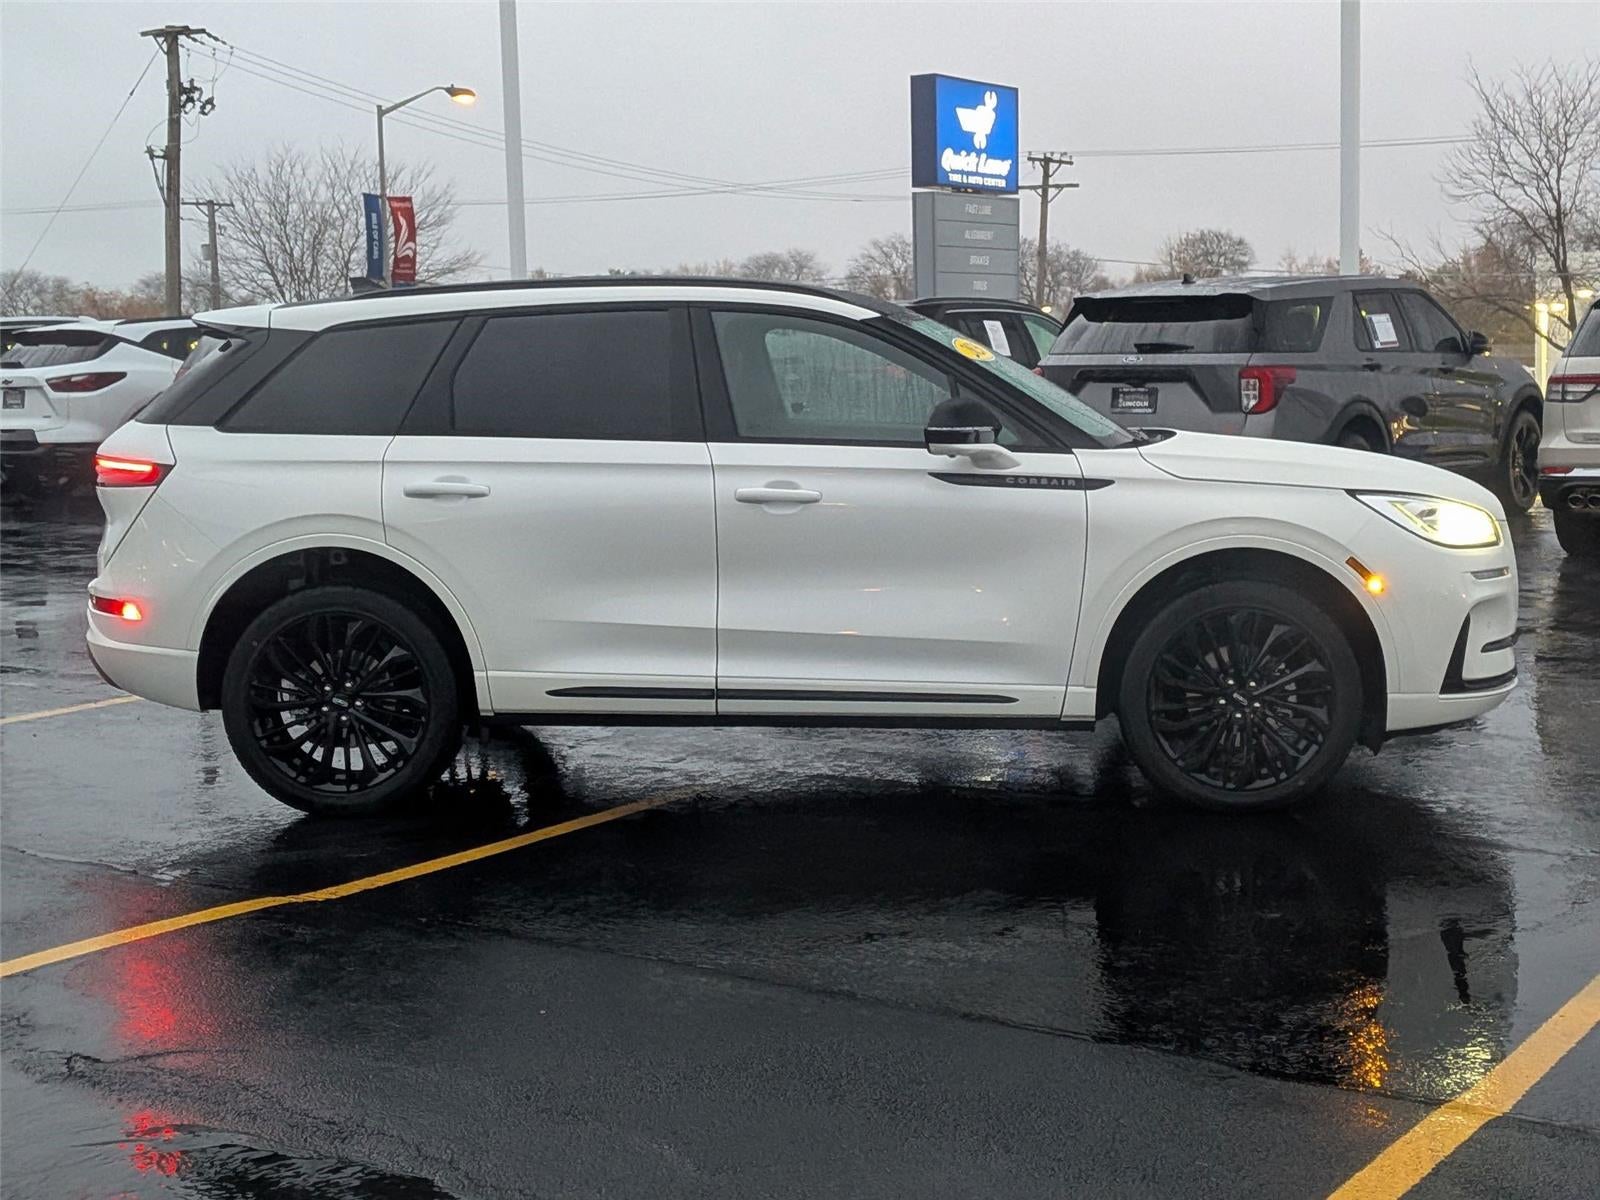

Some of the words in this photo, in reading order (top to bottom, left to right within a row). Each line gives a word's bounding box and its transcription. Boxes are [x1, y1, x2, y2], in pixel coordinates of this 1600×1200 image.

[941, 147, 979, 172] Quick
[977, 152, 1013, 177] Lane
[1006, 477, 1076, 486] CORSAIR
